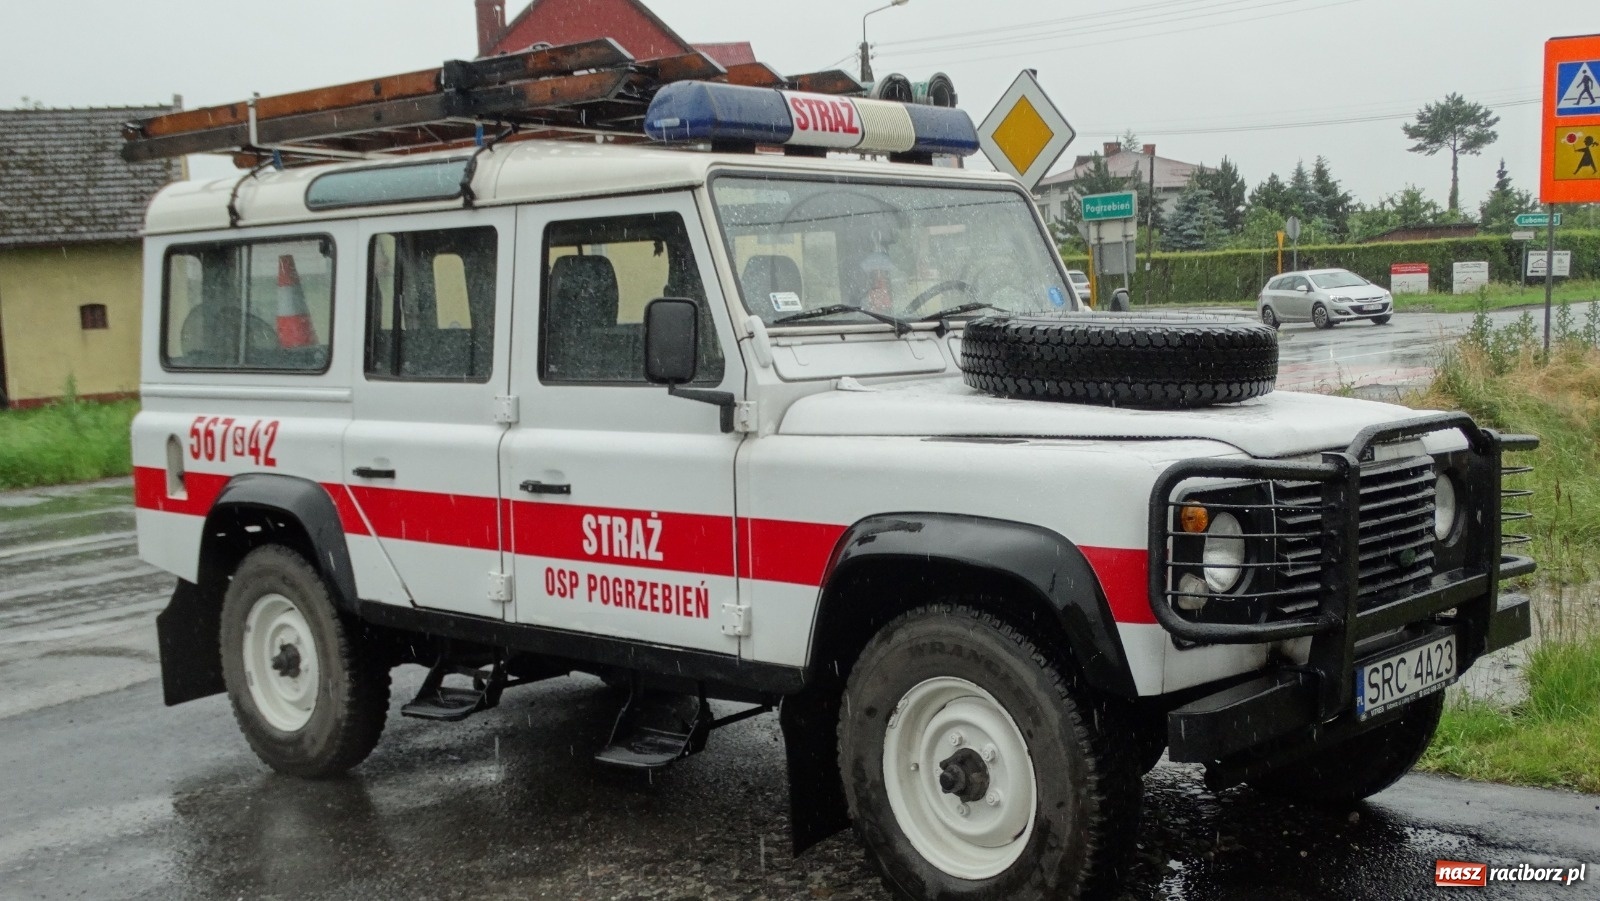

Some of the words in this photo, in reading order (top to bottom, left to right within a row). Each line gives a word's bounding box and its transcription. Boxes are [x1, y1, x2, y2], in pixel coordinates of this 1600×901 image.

[790, 96, 859, 134] STRAŻ
[1085, 201, 1130, 214] Pogrzebień
[582, 511, 663, 561] STRAŻ
[545, 566, 579, 599] OSP
[587, 573, 709, 619] POGRZEBIEŃ
[1368, 657, 1407, 705] SRC
[1414, 639, 1453, 685] 4A23
[1356, 695, 1364, 707] PL
